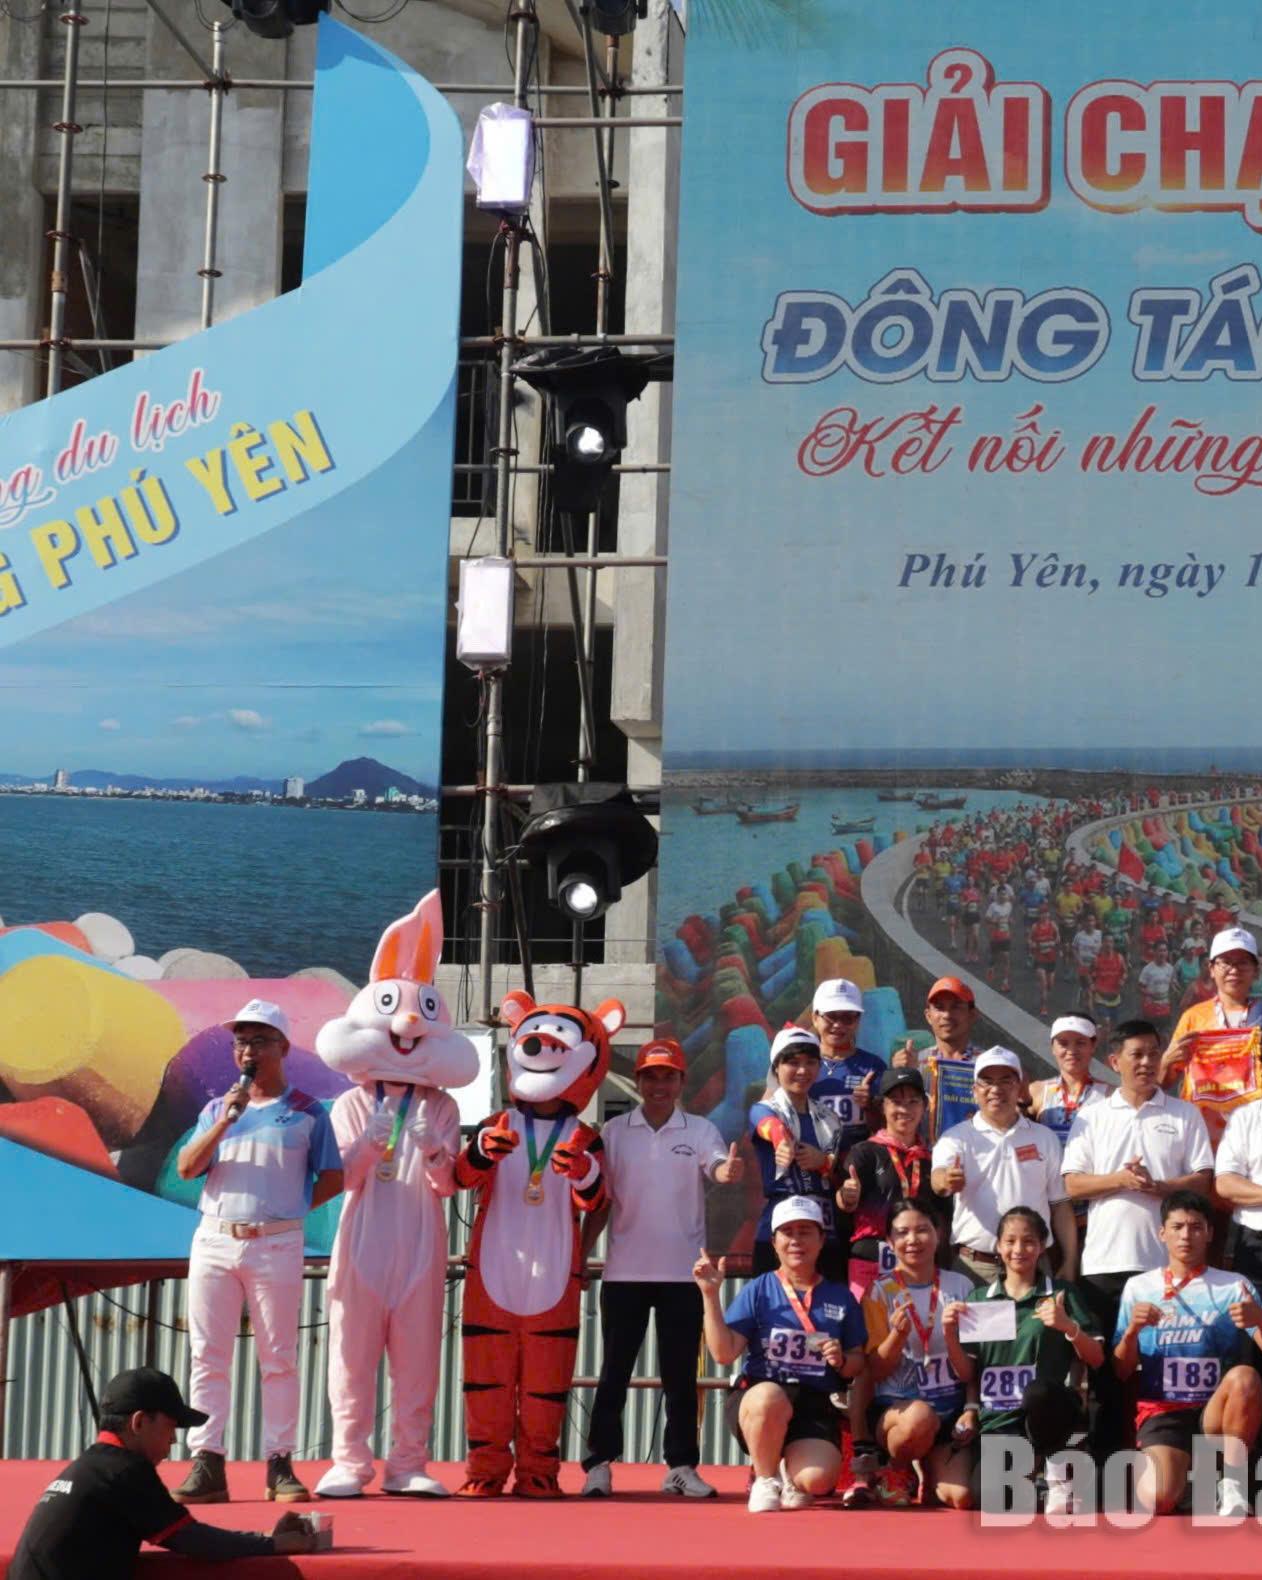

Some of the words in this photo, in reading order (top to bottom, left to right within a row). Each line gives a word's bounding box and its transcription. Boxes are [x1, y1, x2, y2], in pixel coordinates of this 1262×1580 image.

[796, 60, 1036, 198] GIẢI
[769, 275, 1103, 376] ĐÔNG
[57, 420, 115, 479] du
[133, 369, 219, 448] lịch
[797, 403, 963, 478] Kết
[967, 403, 1066, 474] nối
[30, 467, 181, 589] PHÚ
[184, 408, 337, 517] YÊN
[896, 552, 987, 588] Phú
[1008, 553, 1101, 596] Yên,
[1117, 553, 1226, 598] ngày
[1158, 1329, 1203, 1345] RUN
[1167, 1361, 1218, 1388] 183
